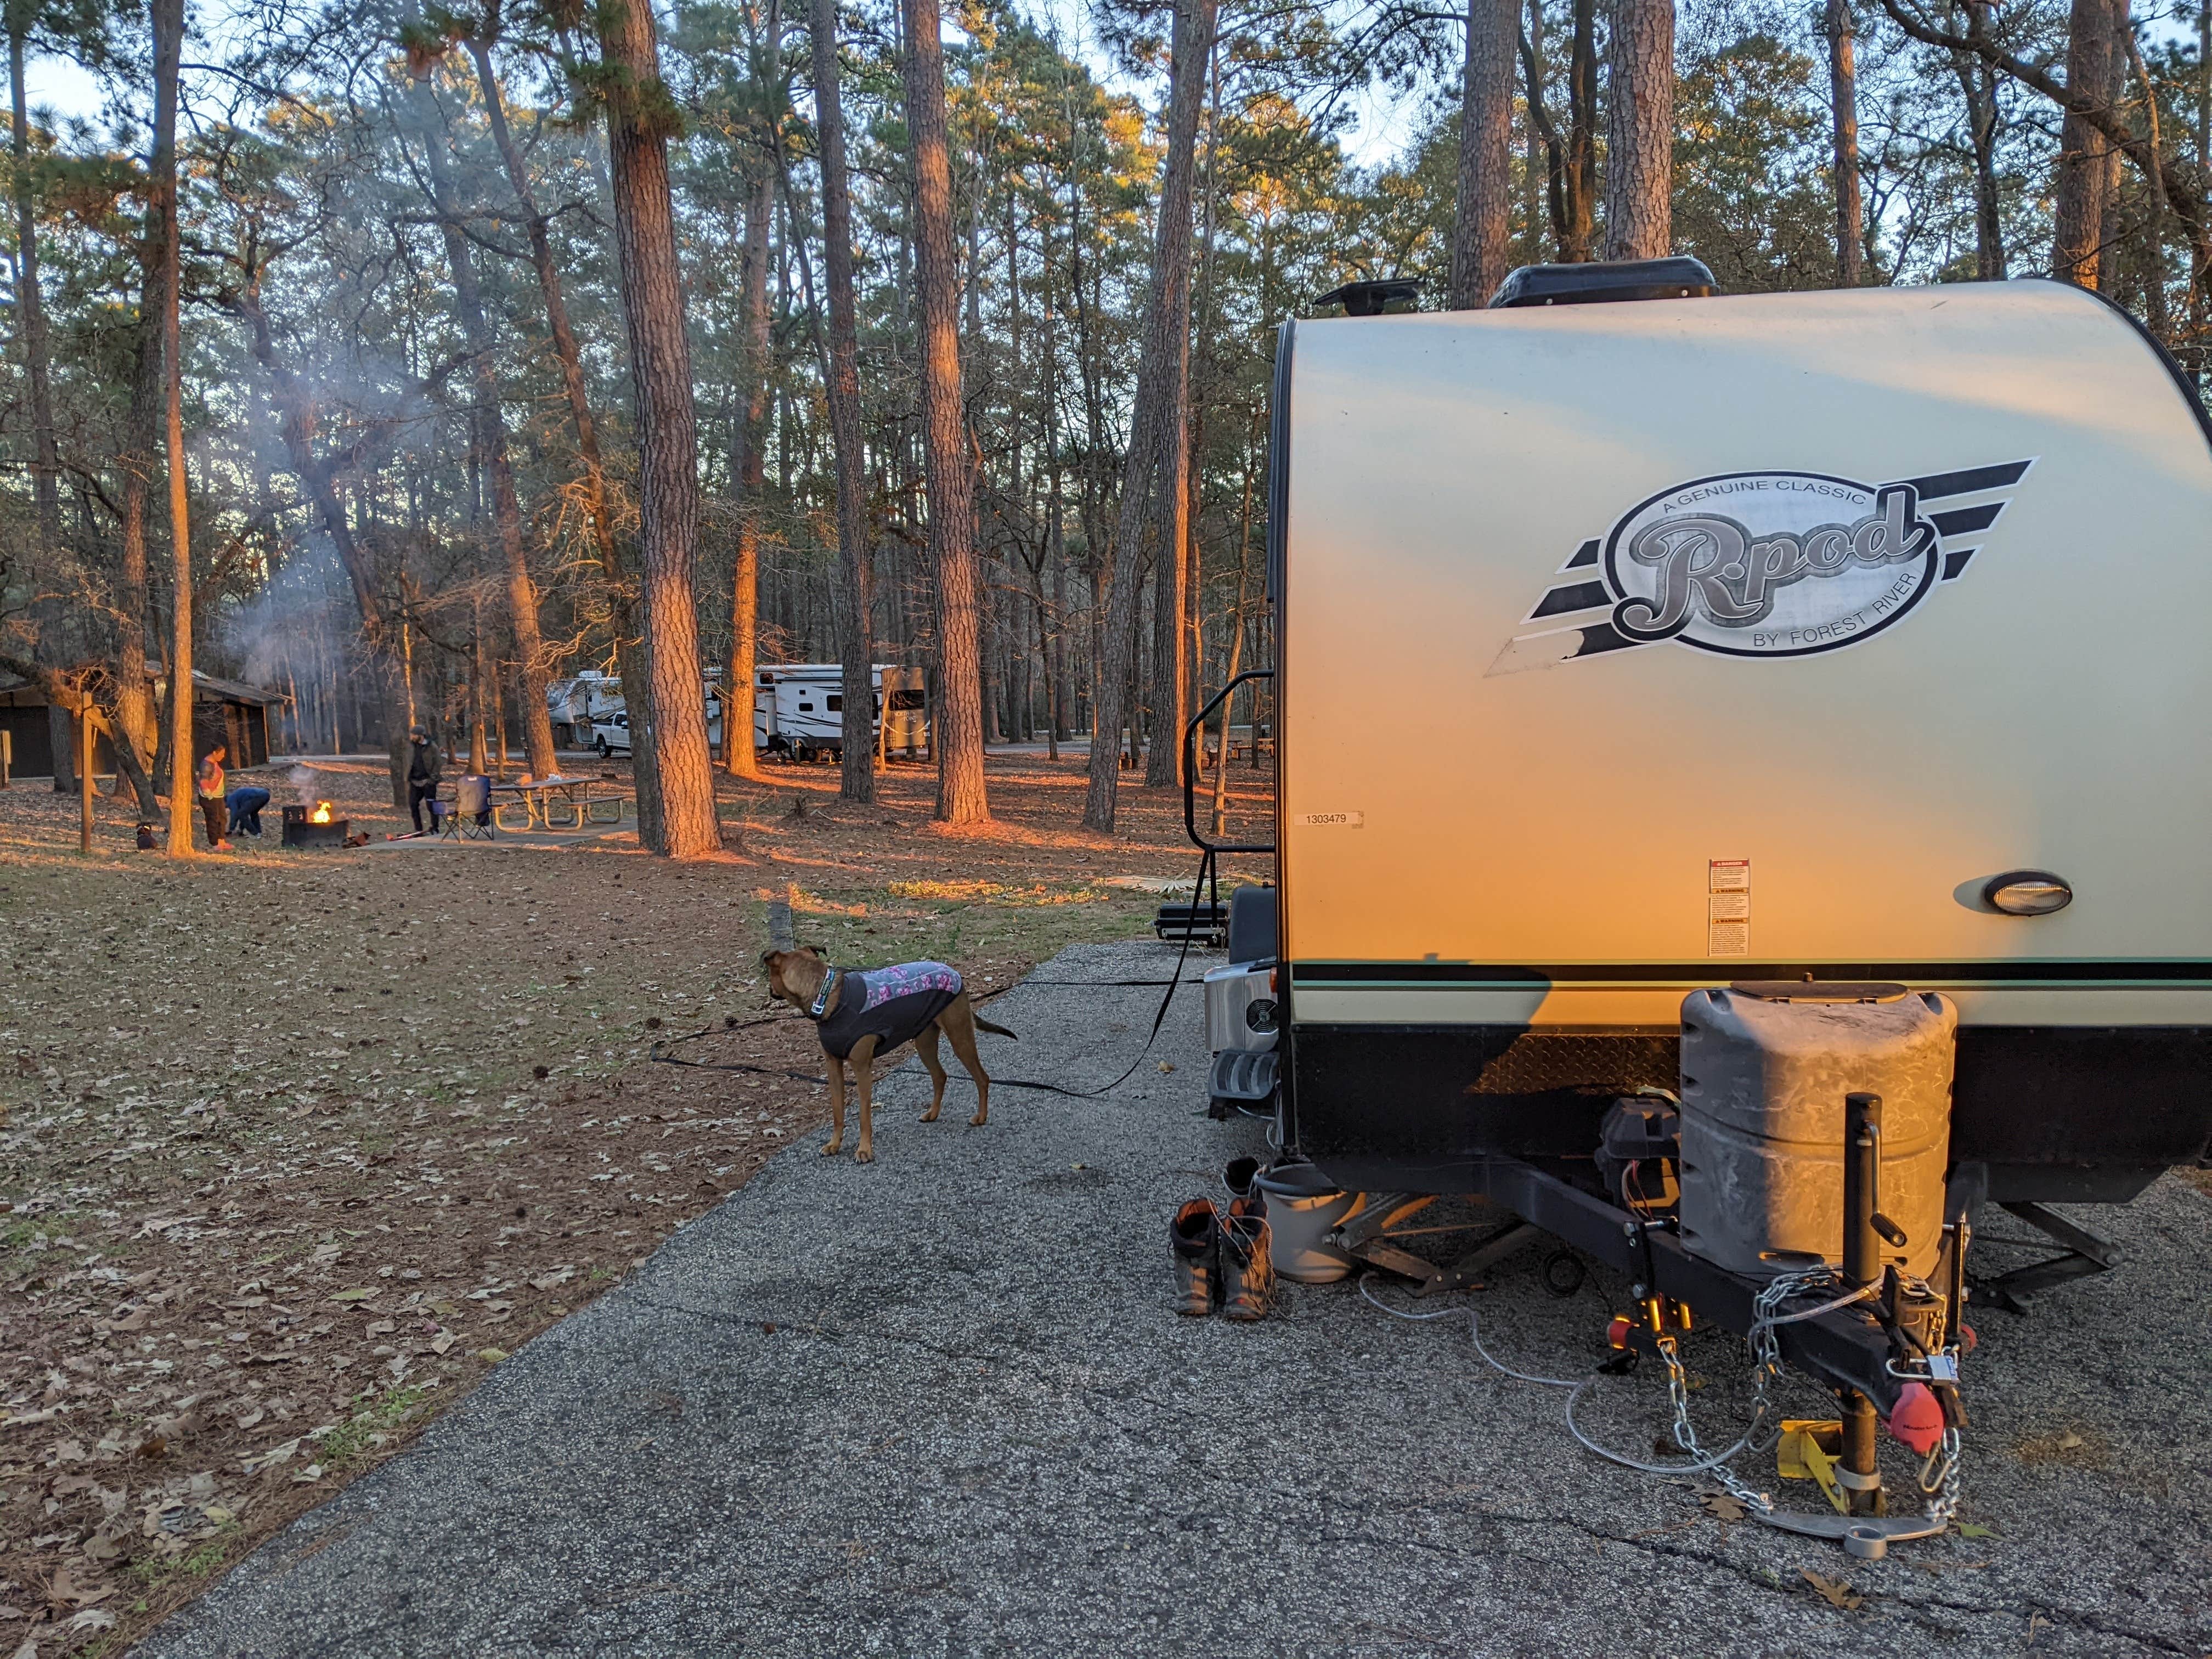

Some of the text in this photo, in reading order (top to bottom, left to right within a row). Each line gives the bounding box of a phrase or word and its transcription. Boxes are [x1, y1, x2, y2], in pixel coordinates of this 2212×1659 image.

[1663, 481, 1866, 514] A GENUINE CLASSIC
[1753, 572, 1917, 647] BY FOREST RIVER
[1306, 814, 1346, 823] 1303479
